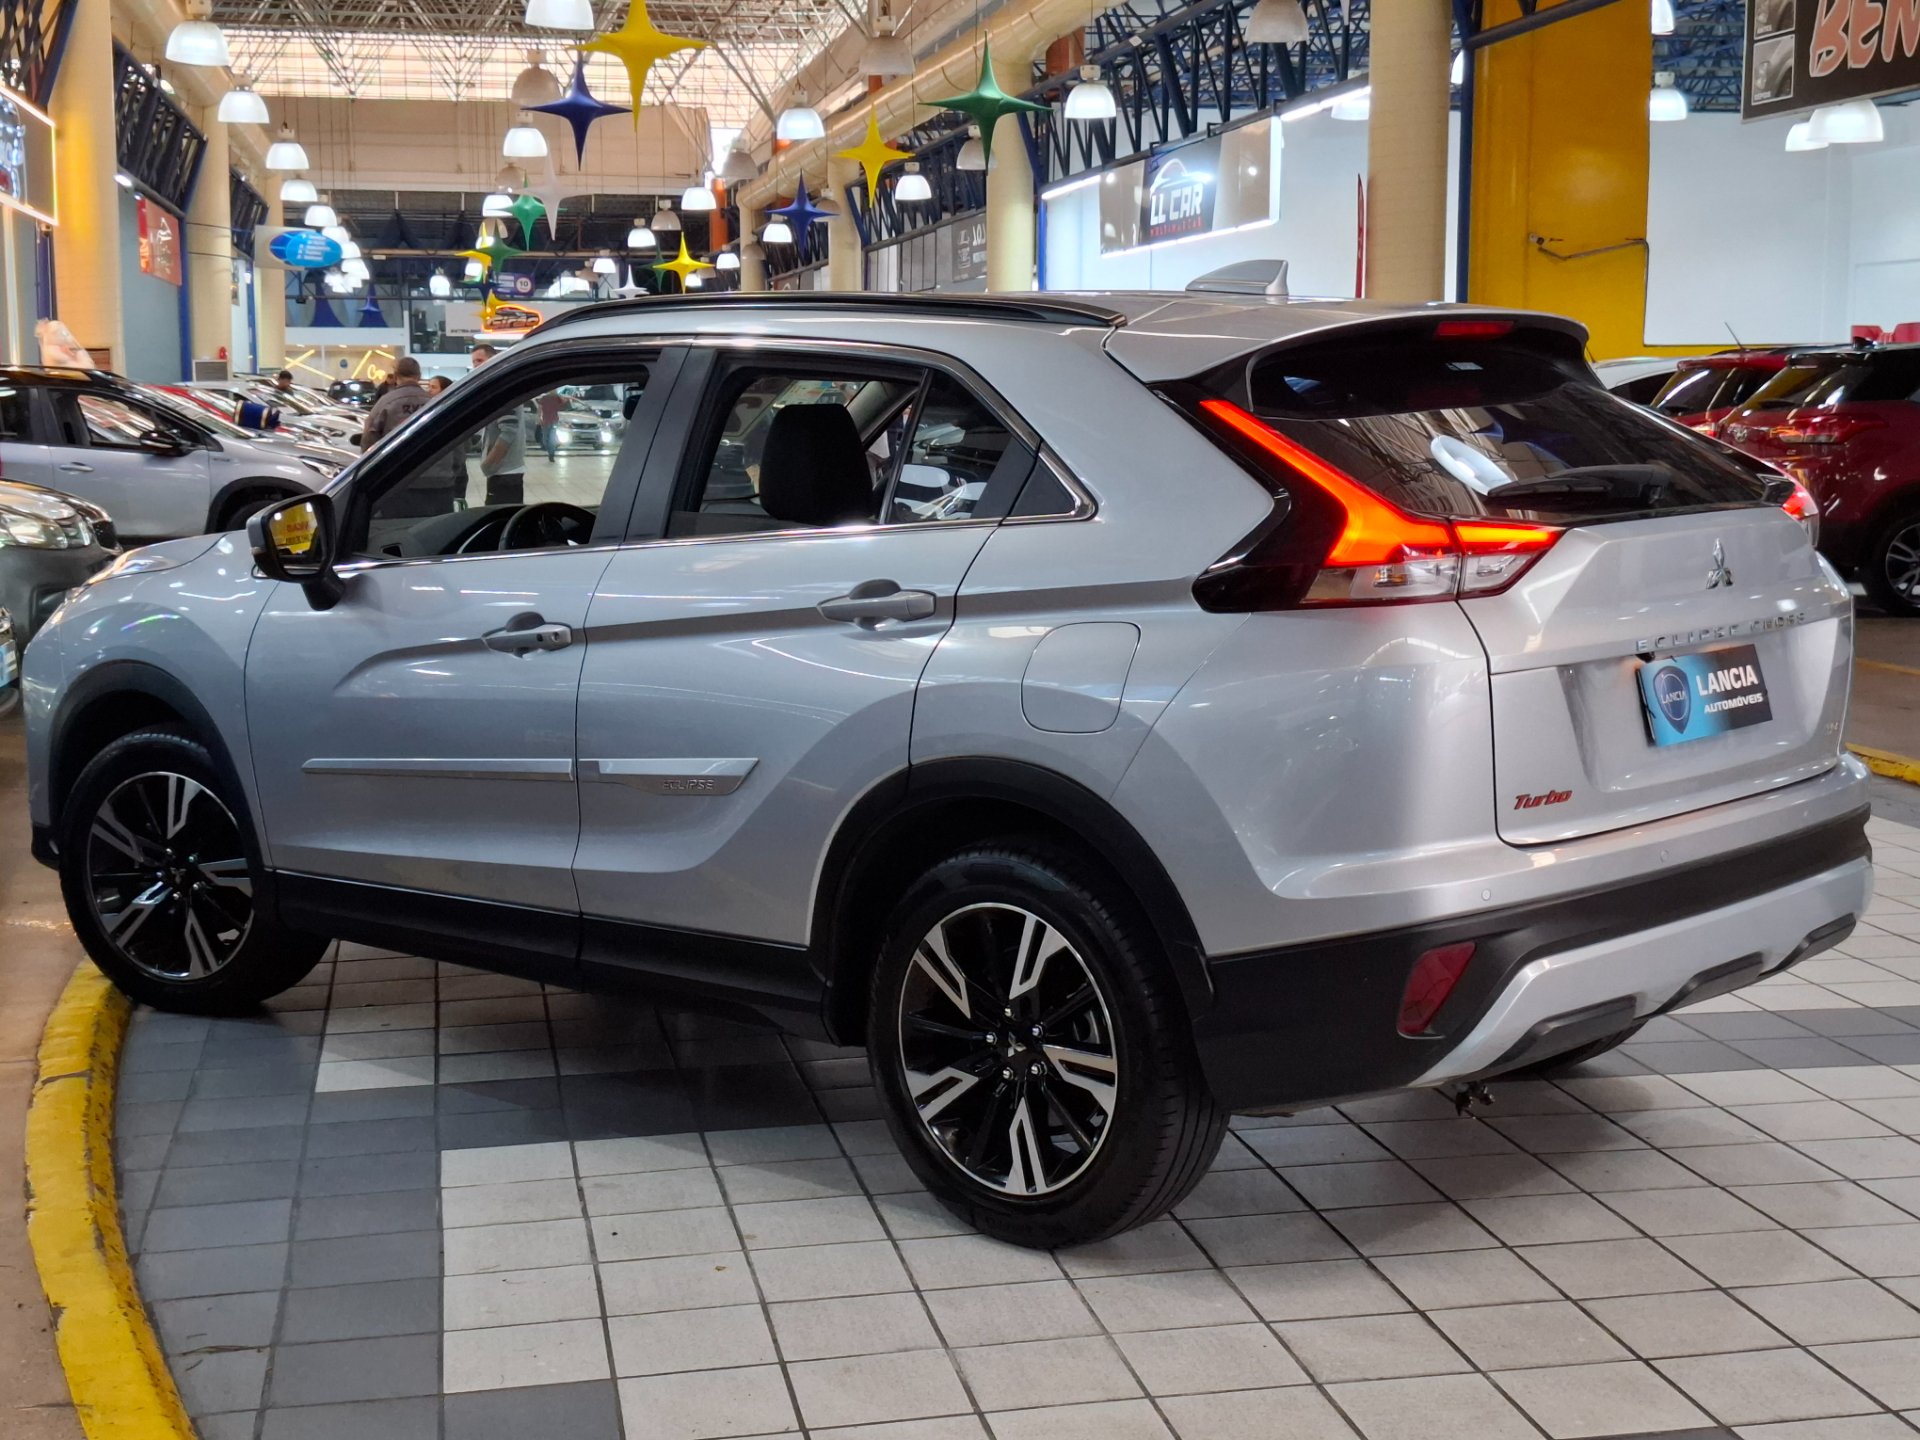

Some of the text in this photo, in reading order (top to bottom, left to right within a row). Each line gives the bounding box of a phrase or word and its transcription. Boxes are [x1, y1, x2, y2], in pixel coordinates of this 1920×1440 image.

[1150, 183, 1204, 226] LL CAR
[1635, 612, 1805, 652] ECLIPSE CROSS
[1696, 664, 1759, 696] LANCIA
[1660, 690, 1688, 704] LANCIA
[1703, 692, 1764, 713] AUTOMÓVEIS
[662, 779, 715, 790] ECLIPSE
[1513, 789, 1573, 810] Turbo
